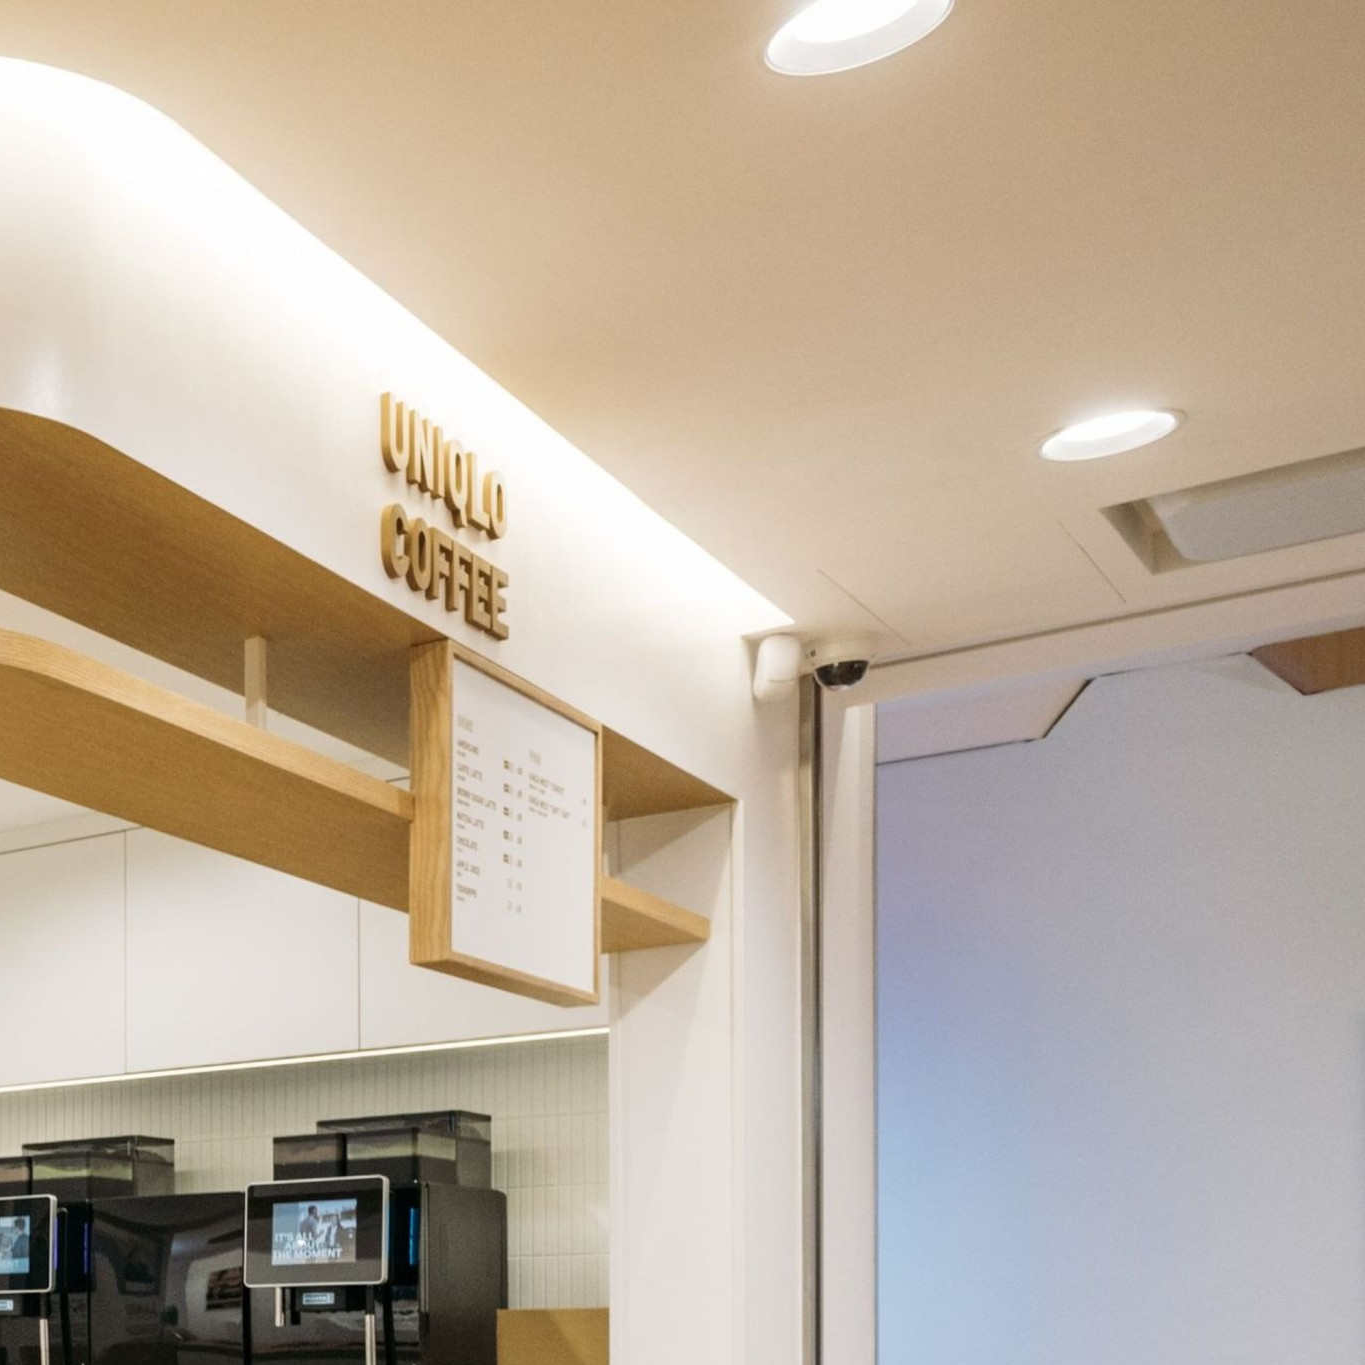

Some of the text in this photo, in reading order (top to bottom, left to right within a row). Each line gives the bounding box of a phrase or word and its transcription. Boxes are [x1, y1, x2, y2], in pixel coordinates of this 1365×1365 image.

[380, 392, 506, 540] UNIQLO
[380, 503, 509, 641] COFFEE
[294, 1248, 342, 1258] MOMENT
